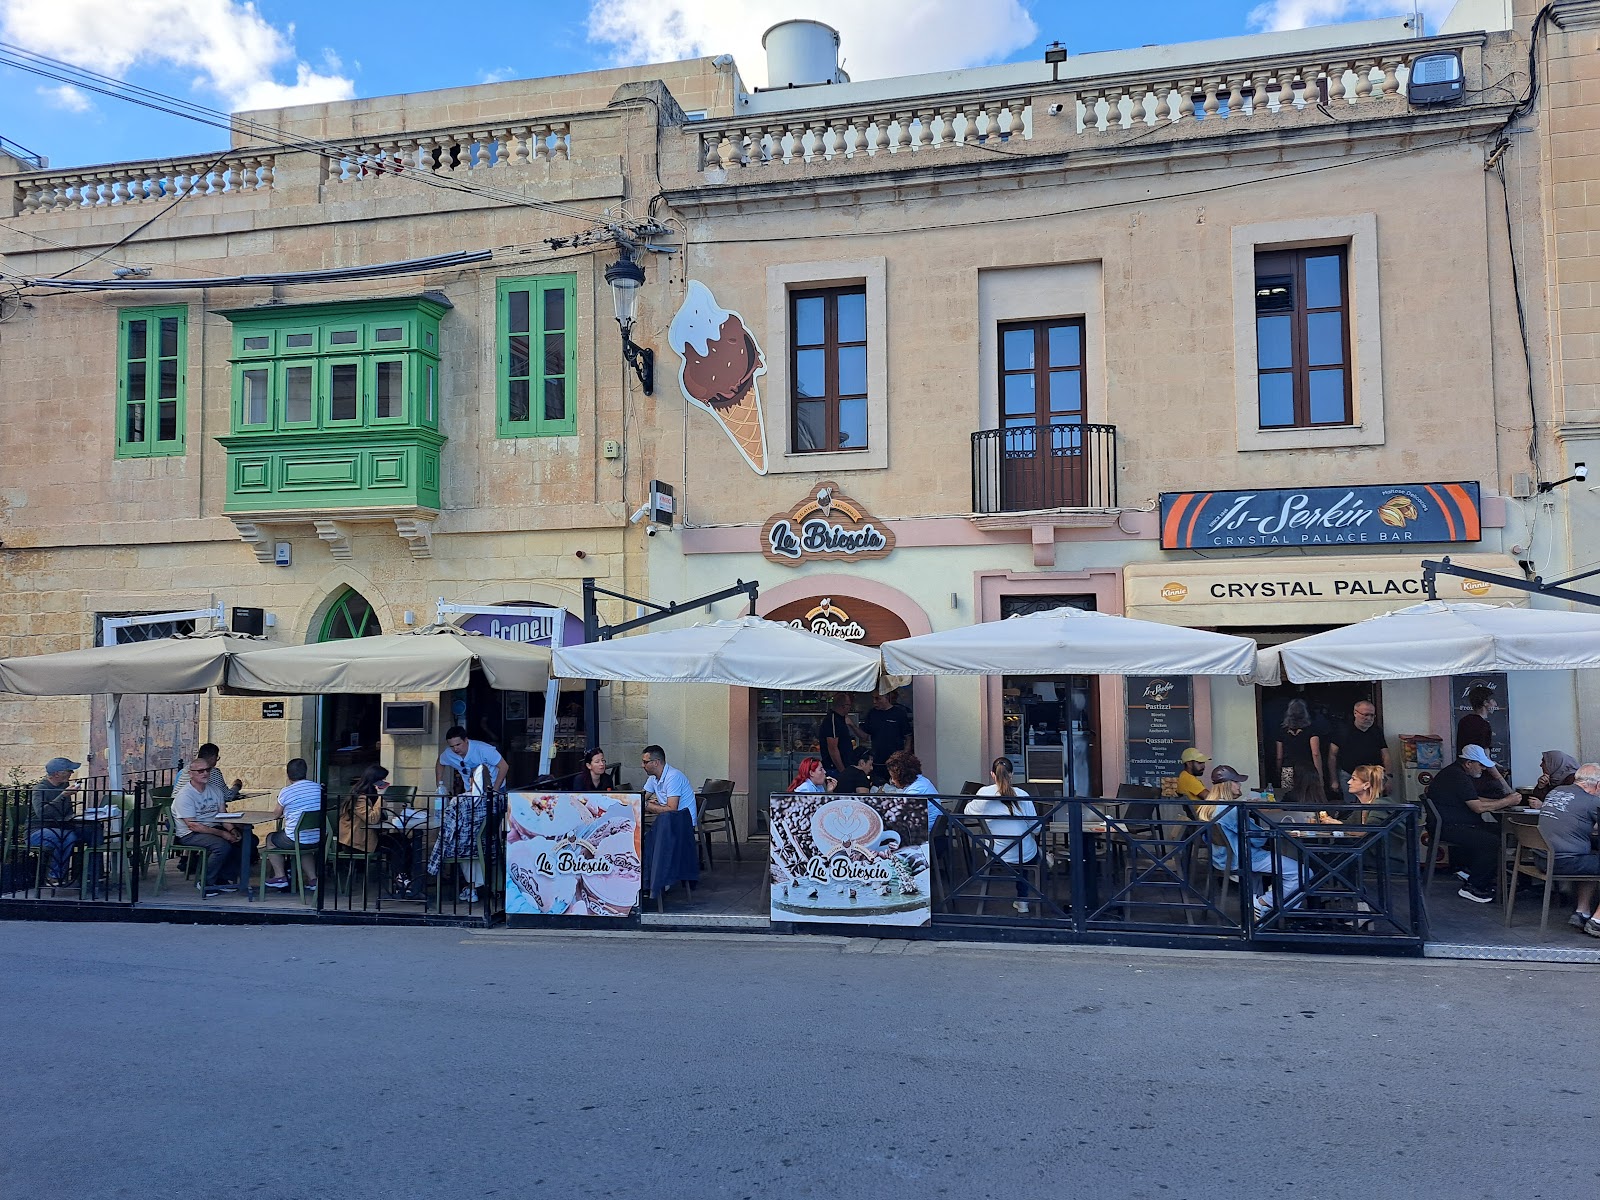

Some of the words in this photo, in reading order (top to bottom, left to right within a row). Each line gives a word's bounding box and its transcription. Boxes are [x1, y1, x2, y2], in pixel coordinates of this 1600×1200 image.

[1207, 491, 1374, 535] Is-Serkin
[771, 522, 799, 556] La
[803, 520, 883, 551] Brioscia
[1213, 535, 1290, 546] CRYSTAL
[1301, 532, 1369, 543] PALACE
[1379, 531, 1413, 541] BAR
[1161, 588, 1188, 597] Kinnie
[1209, 581, 1323, 598] CRYSTAL
[1145, 737, 1173, 745] Qassatat
[536, 852, 554, 876] La
[557, 852, 611, 874] Brioscia
[808, 858, 828, 882] La
[832, 858, 889, 880] Brioscia
